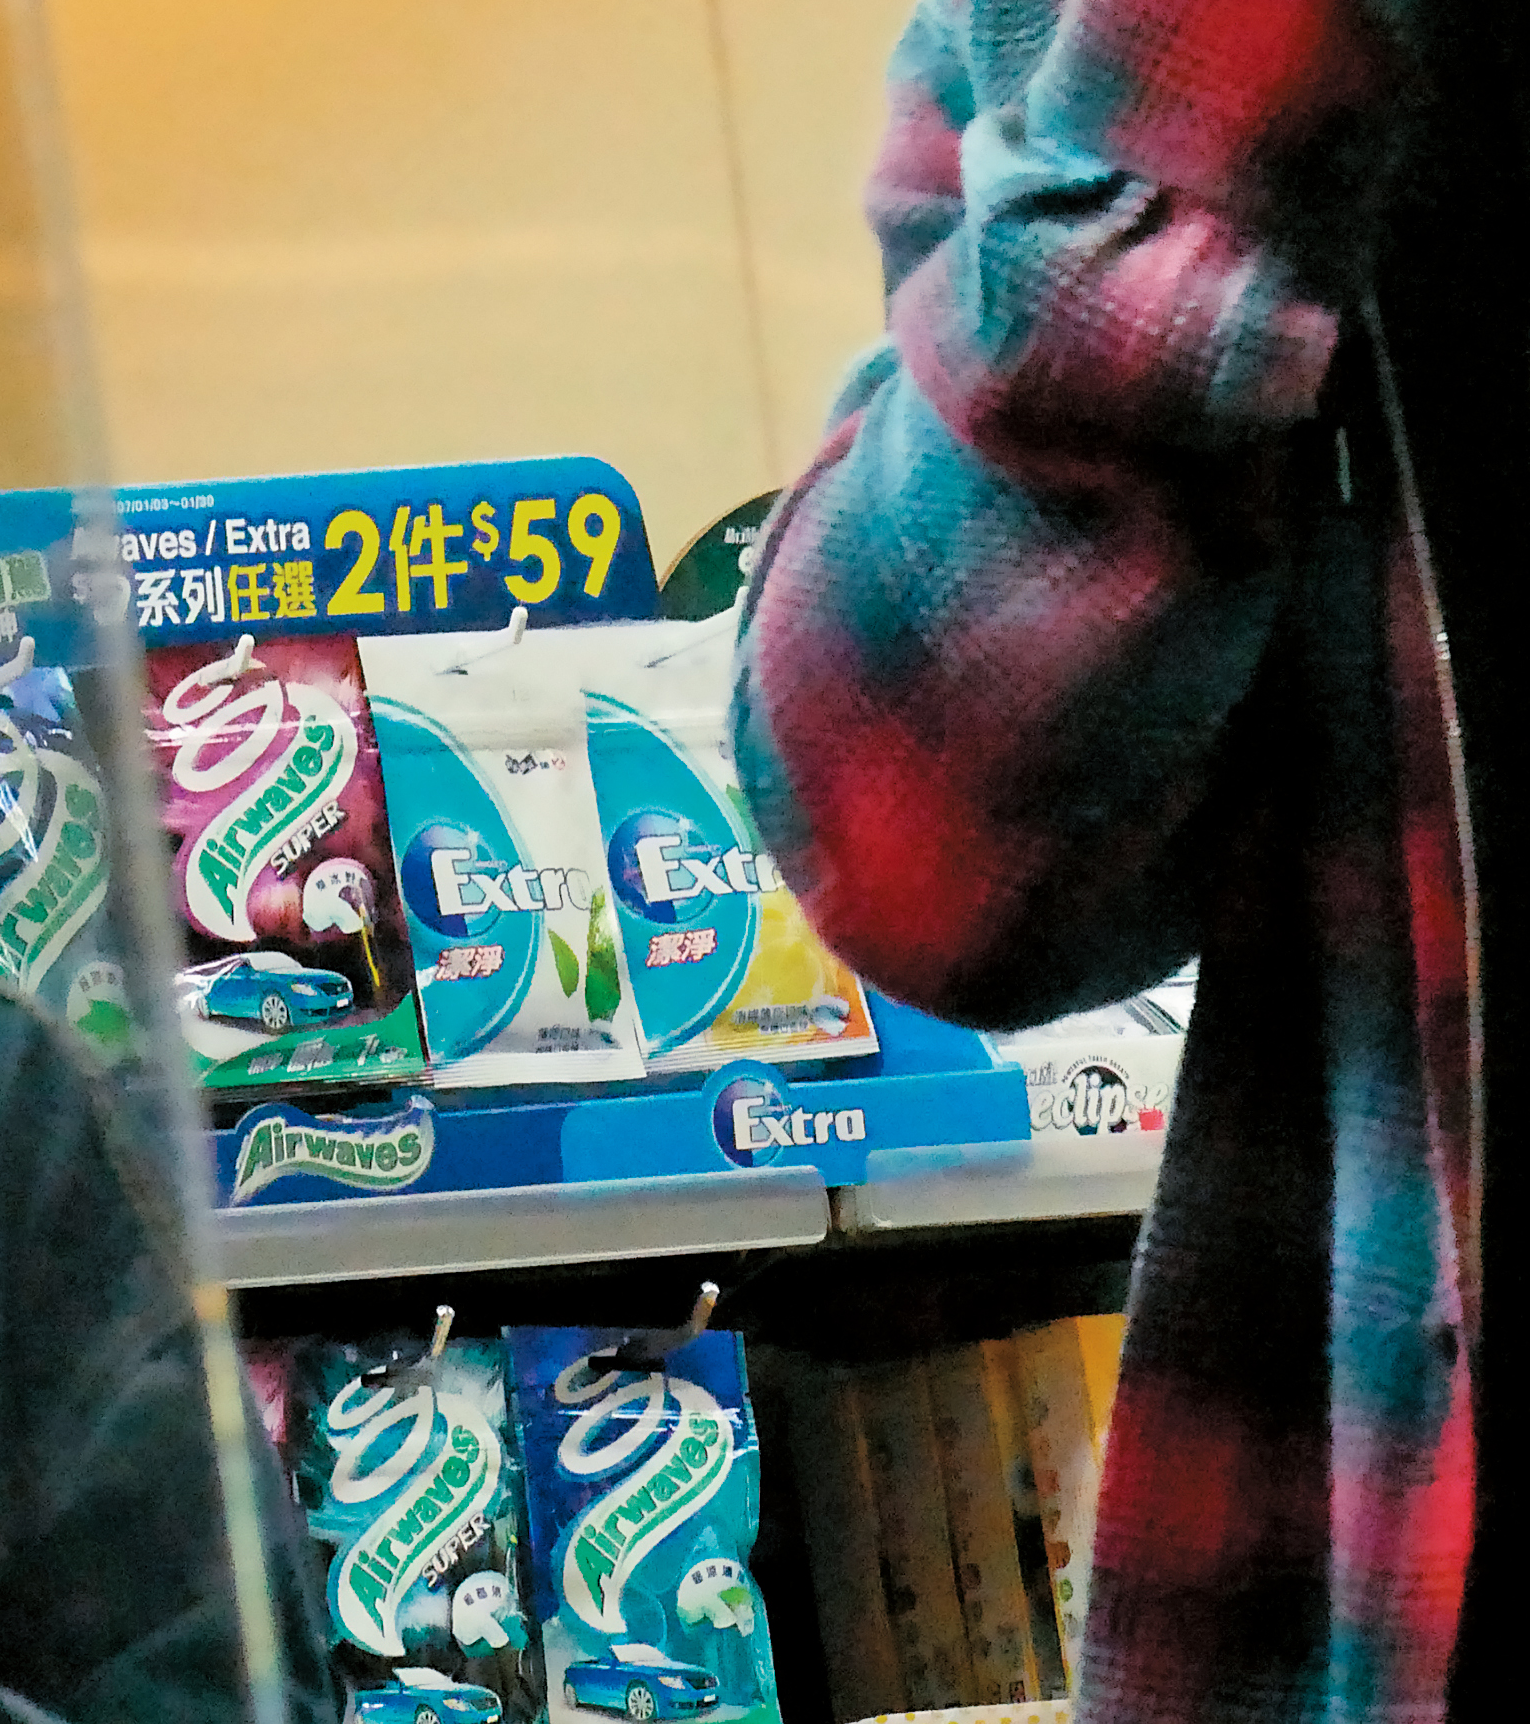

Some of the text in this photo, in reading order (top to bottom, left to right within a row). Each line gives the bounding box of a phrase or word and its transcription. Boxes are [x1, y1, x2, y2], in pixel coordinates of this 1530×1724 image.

[225, 517, 311, 555] Extra
[197, 713, 336, 926] Airwaves
[270, 799, 347, 878] SUPER
[430, 846, 593, 917] Extra
[634, 832, 786, 906] Extr
[731, 1096, 867, 1151] Extra
[1031, 1072, 1170, 1135] eclipse
[238, 1121, 424, 1178] Airwaves
[348, 1424, 481, 1639] Airwaves
[421, 1512, 491, 1588] SUPER
[574, 1412, 720, 1619] Airwaves
